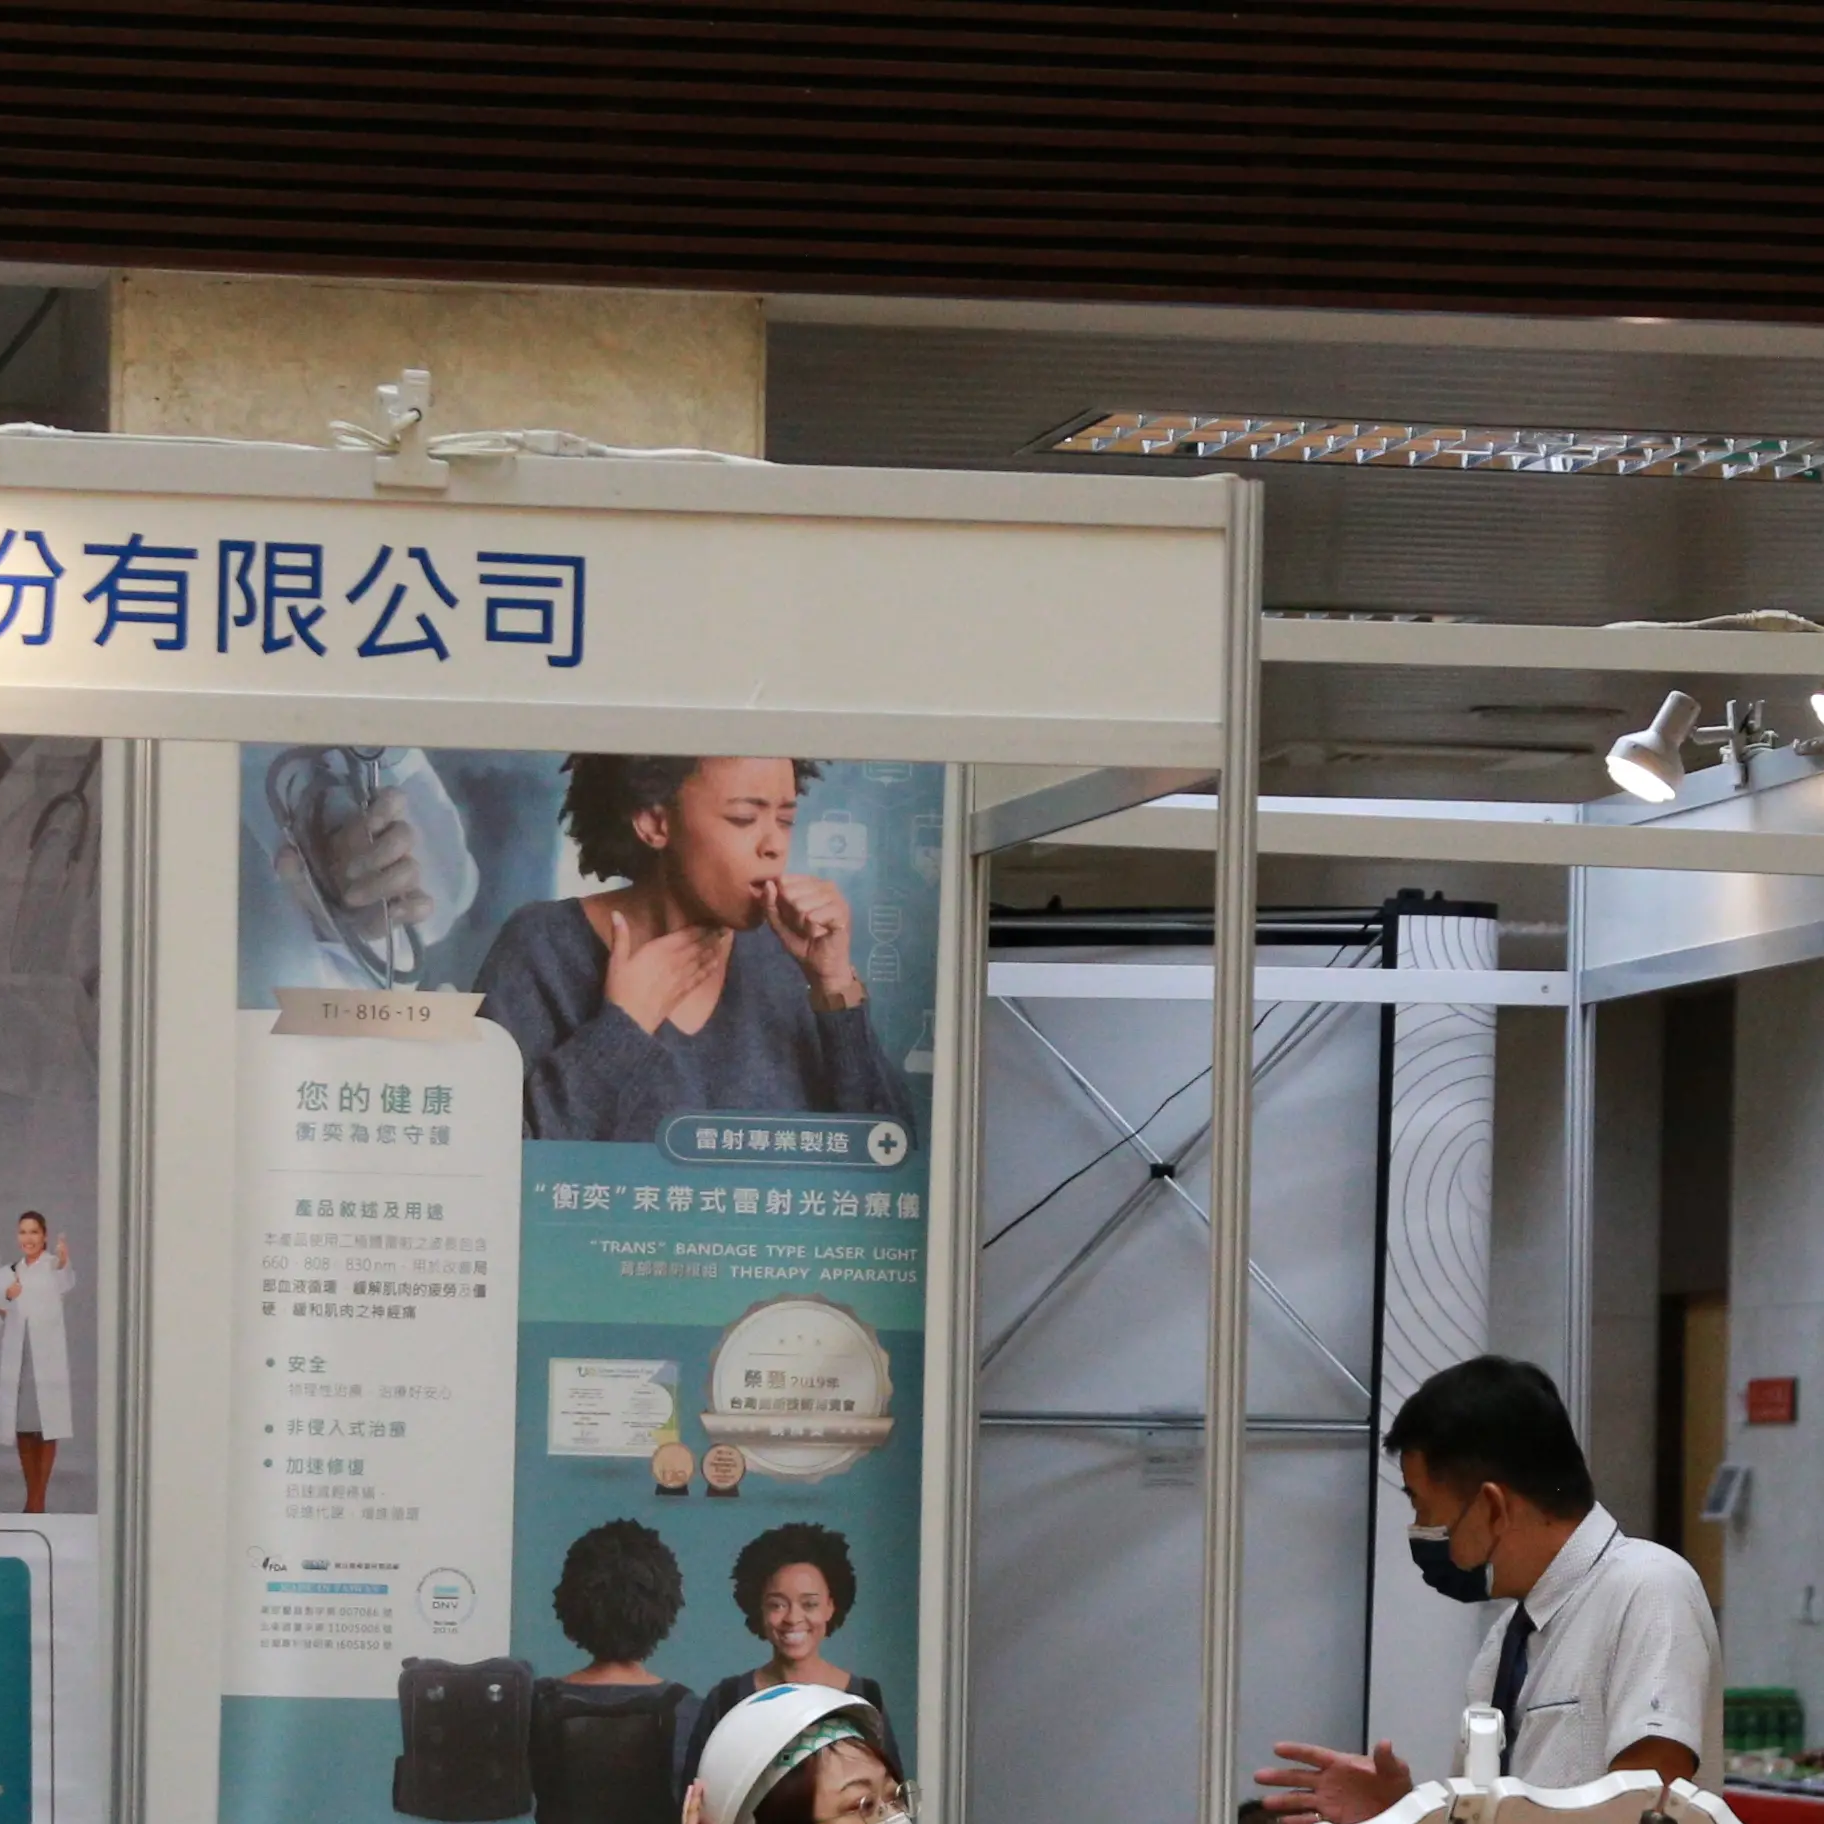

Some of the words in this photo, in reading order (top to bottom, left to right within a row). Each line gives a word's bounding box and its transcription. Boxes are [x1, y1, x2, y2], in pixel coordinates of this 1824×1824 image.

[296, 1079, 454, 1116] 您的健康
[295, 1122, 452, 1147] 衡奕為您守護
[695, 1126, 850, 1154] 雷射專業製造
[294, 1199, 444, 1221] 產品敘述及用途
[675, 1241, 758, 1258] BANDAGE
[765, 1243, 807, 1259] TYPE
[814, 1245, 865, 1260] LASER
[872, 1246, 918, 1262] LIGHT
[729, 1264, 810, 1281] THERAPY
[819, 1266, 918, 1284] APPARATUS
[288, 1355, 327, 1374] 安全
[287, 1418, 407, 1438] 非侵入式治療
[285, 1456, 365, 1476] 加速修復
[431, 1600, 459, 1610] DNV
